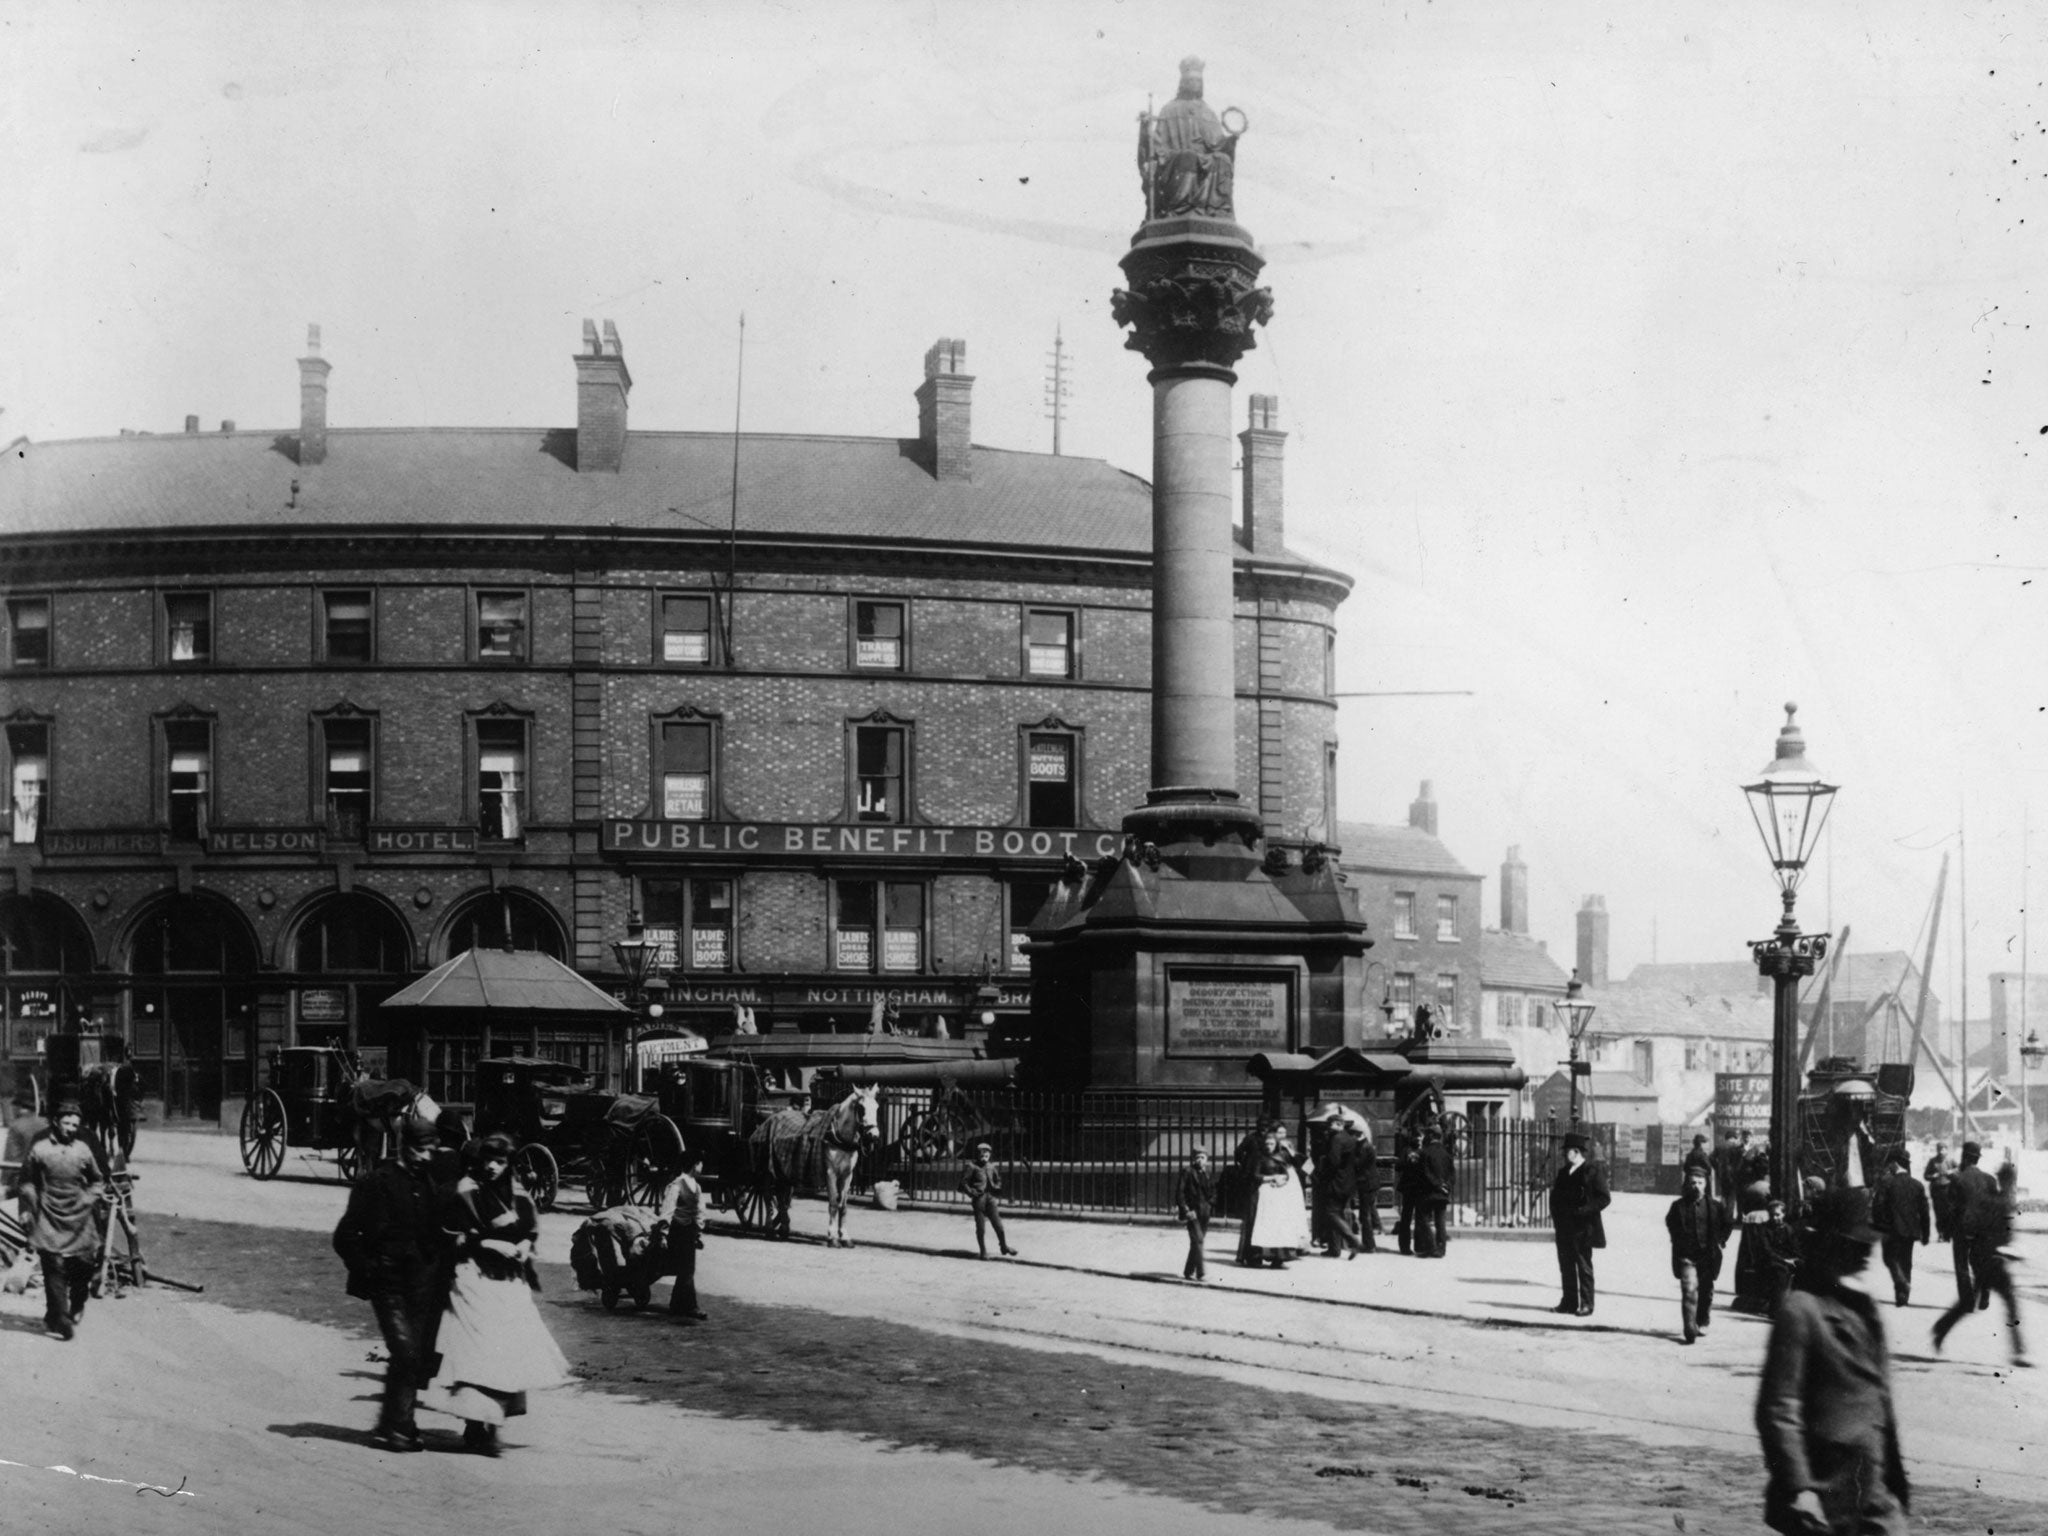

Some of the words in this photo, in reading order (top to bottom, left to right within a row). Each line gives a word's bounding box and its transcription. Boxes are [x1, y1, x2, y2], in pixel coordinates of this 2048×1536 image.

[1031, 763, 1065, 775] BOOTS
[666, 799, 704, 812] RETAIL
[213, 832, 316, 849] NELSON
[376, 832, 473, 850] HOTEL.
[614, 822, 760, 849] PUBLIC
[784, 826, 954, 853] BENEFIT
[975, 830, 1078, 855] BOOT
[1095, 834, 1127, 857] C
[646, 929, 679, 941] LADIES
[695, 930, 727, 941] LADIES
[840, 931, 871, 943] LADIES
[696, 950, 728, 961] BOOTS
[840, 952, 871, 964] SHOES
[886, 953, 918, 964] SHOES
[613, 987, 762, 1002] BIRINGHAM.
[806, 988, 953, 1004] NOTTINGHAM.
[1719, 1079, 1743, 1092] SITE
[1749, 1079, 1770, 1093] FOR
[1731, 1093, 1762, 1103] NEW
[1717, 1104, 1741, 1117] SHOW
